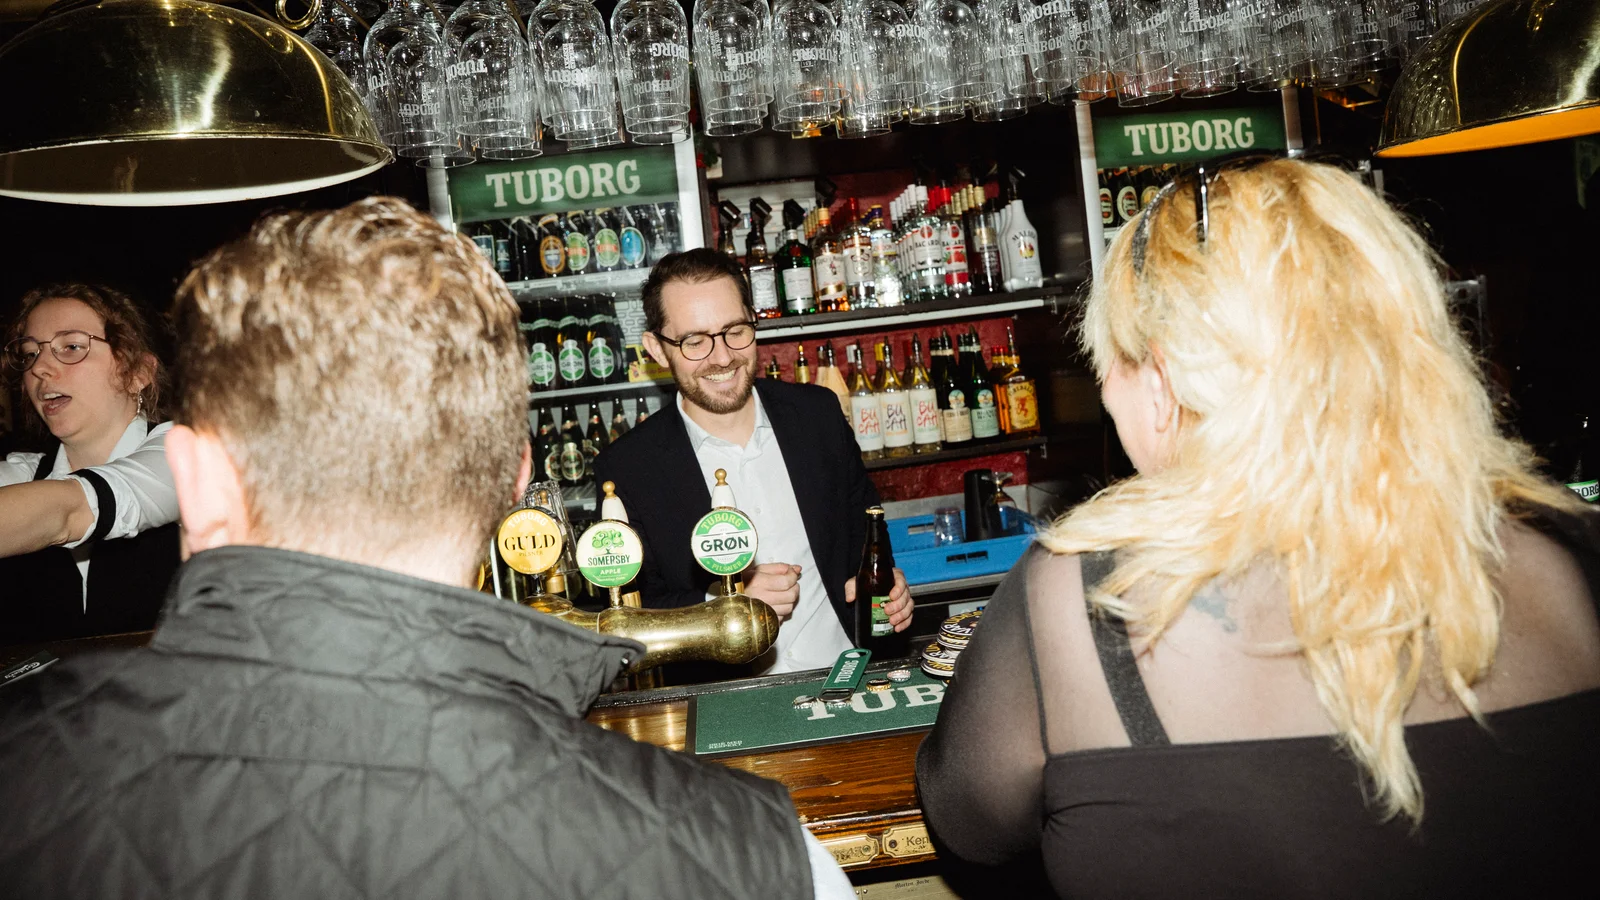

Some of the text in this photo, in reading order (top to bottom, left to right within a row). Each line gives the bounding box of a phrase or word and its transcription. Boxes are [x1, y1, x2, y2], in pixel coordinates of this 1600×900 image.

[1124, 117, 1255, 156] TUBORG
[485, 159, 641, 208] TUBORG
[507, 511, 548, 528] TUBORG
[701, 512, 744, 530] TUBORG
[504, 534, 556, 551] GULD
[700, 536, 749, 553] GRØN
[587, 554, 630, 566] SOMERSBY
[712, 561, 743, 572] PILSNER
[834, 659, 859, 684] TUBORG
